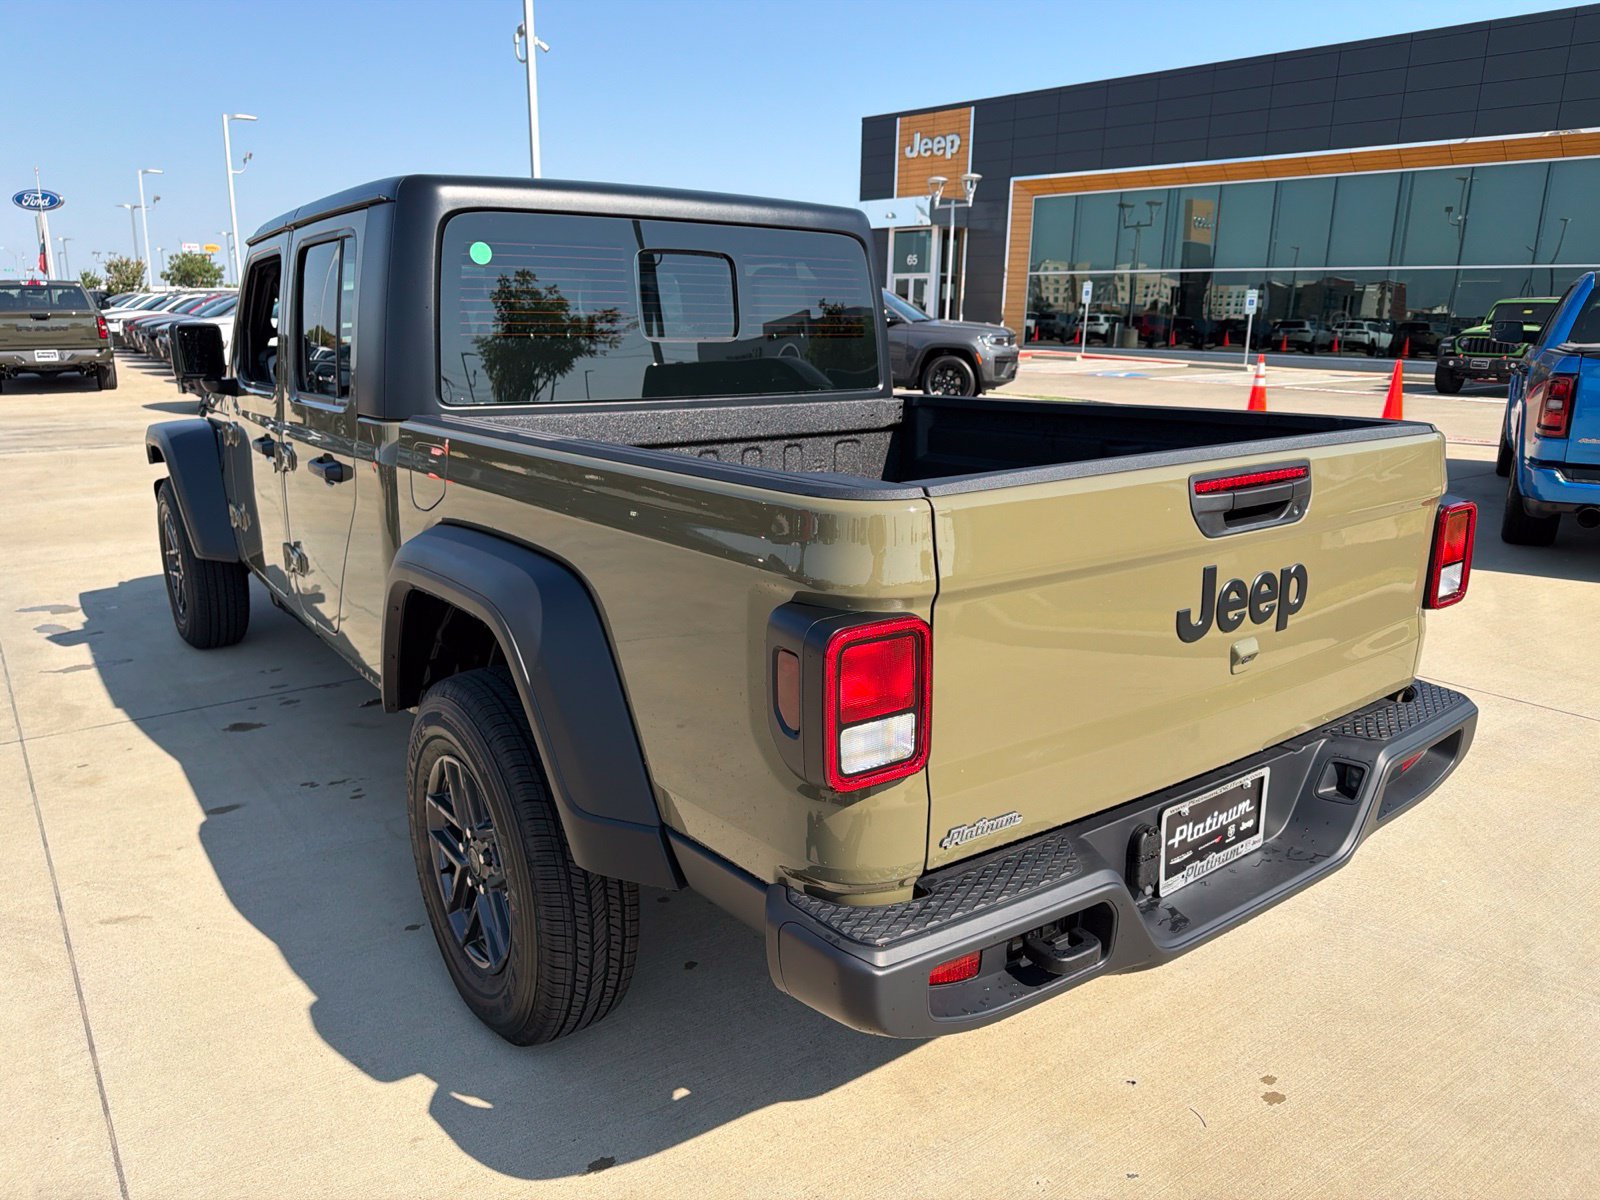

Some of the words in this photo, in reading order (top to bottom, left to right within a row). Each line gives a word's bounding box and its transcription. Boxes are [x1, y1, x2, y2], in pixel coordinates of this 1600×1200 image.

[905, 132, 961, 160] Jeep
[21, 193, 51, 206] Ford
[906, 254, 918, 266] 65
[1176, 562, 1308, 644] Jeep
[941, 811, 1023, 849] Platinum
[1167, 799, 1255, 848] Platinum
[1184, 847, 1244, 882] Platinum
